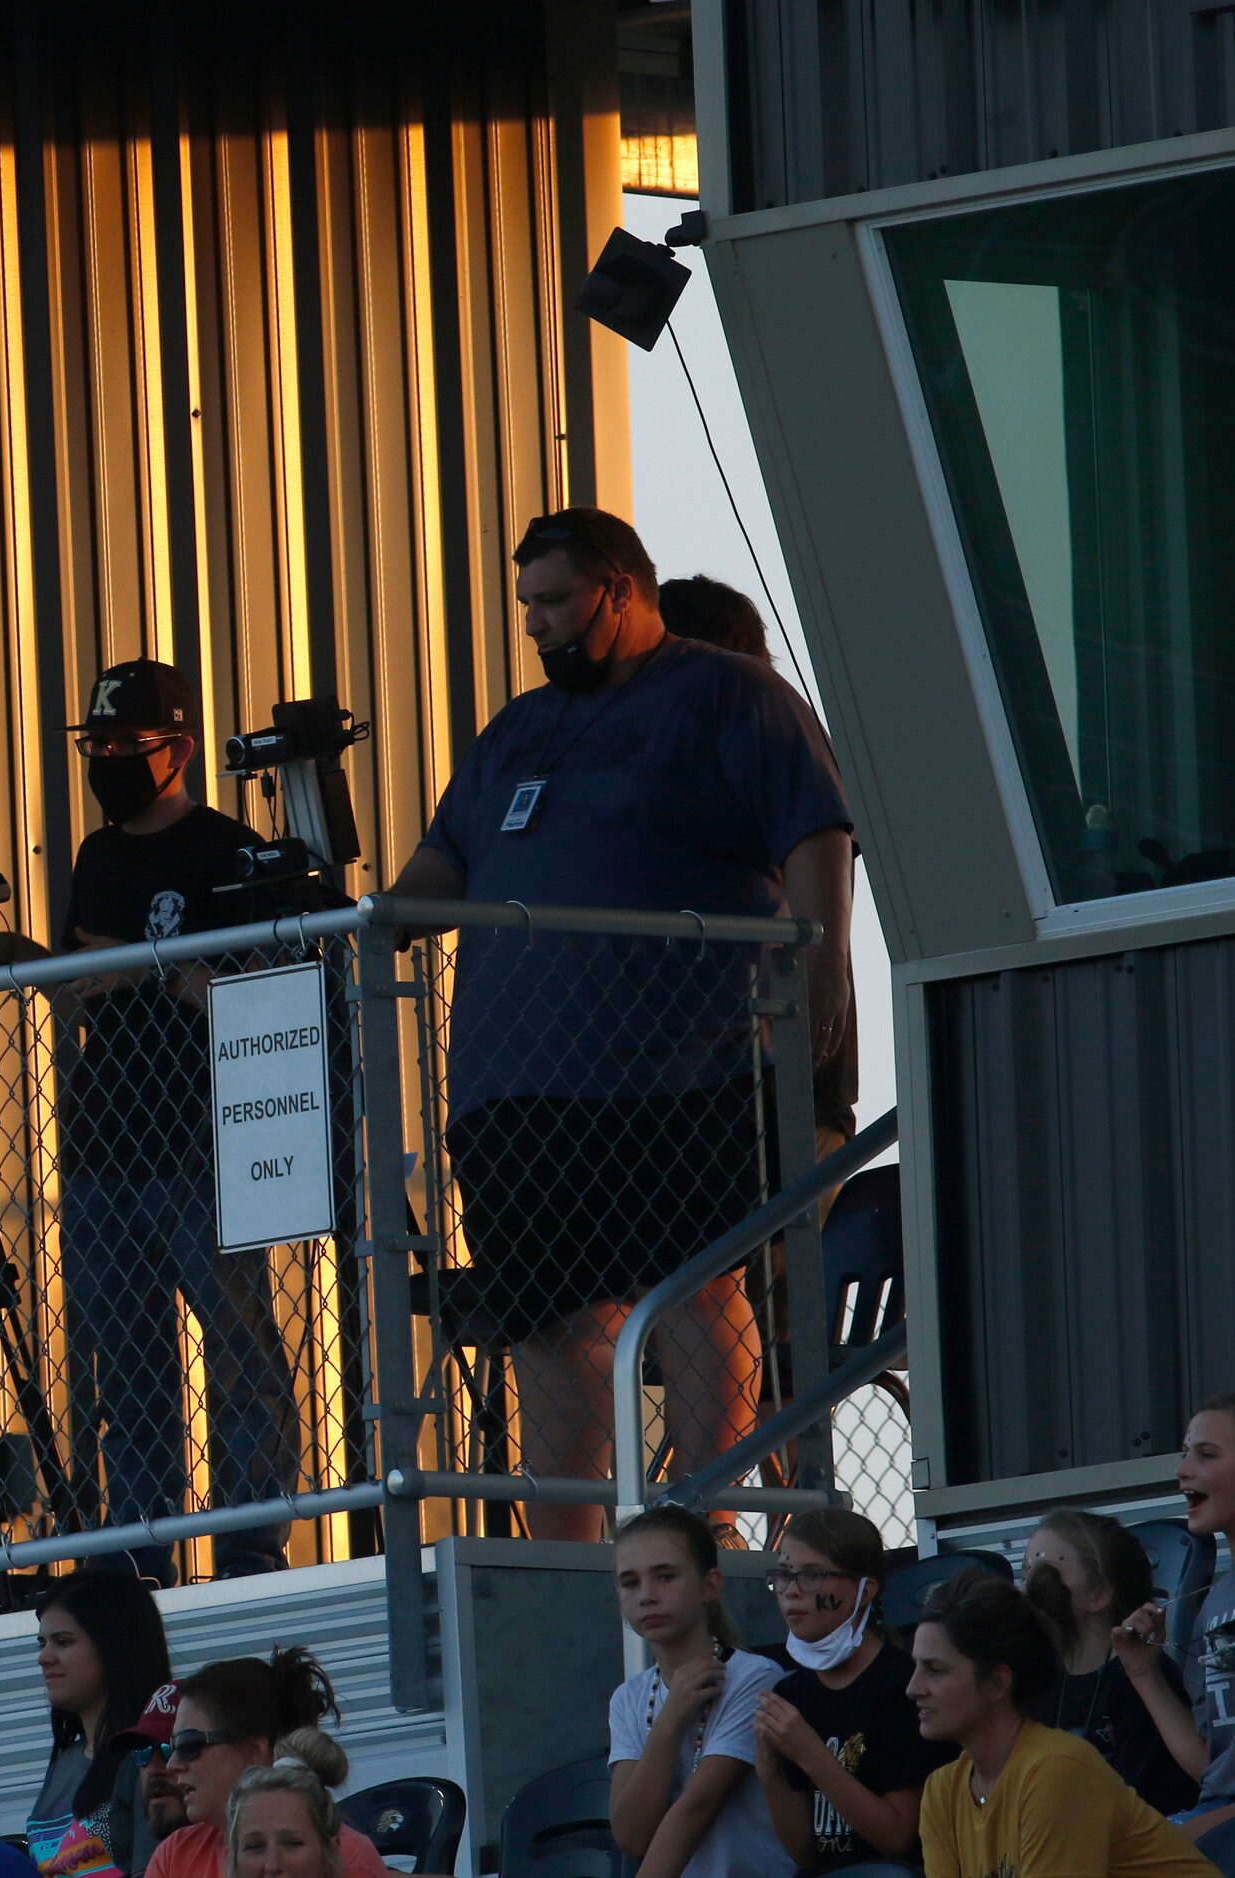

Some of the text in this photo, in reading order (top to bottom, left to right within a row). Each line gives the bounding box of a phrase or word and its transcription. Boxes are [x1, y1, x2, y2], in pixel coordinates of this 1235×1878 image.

[92, 680, 122, 716] K
[218, 1026, 320, 1062] AUTHORIZED
[222, 1091, 319, 1126] PERSONNEL
[251, 1155, 294, 1181] ONLY
